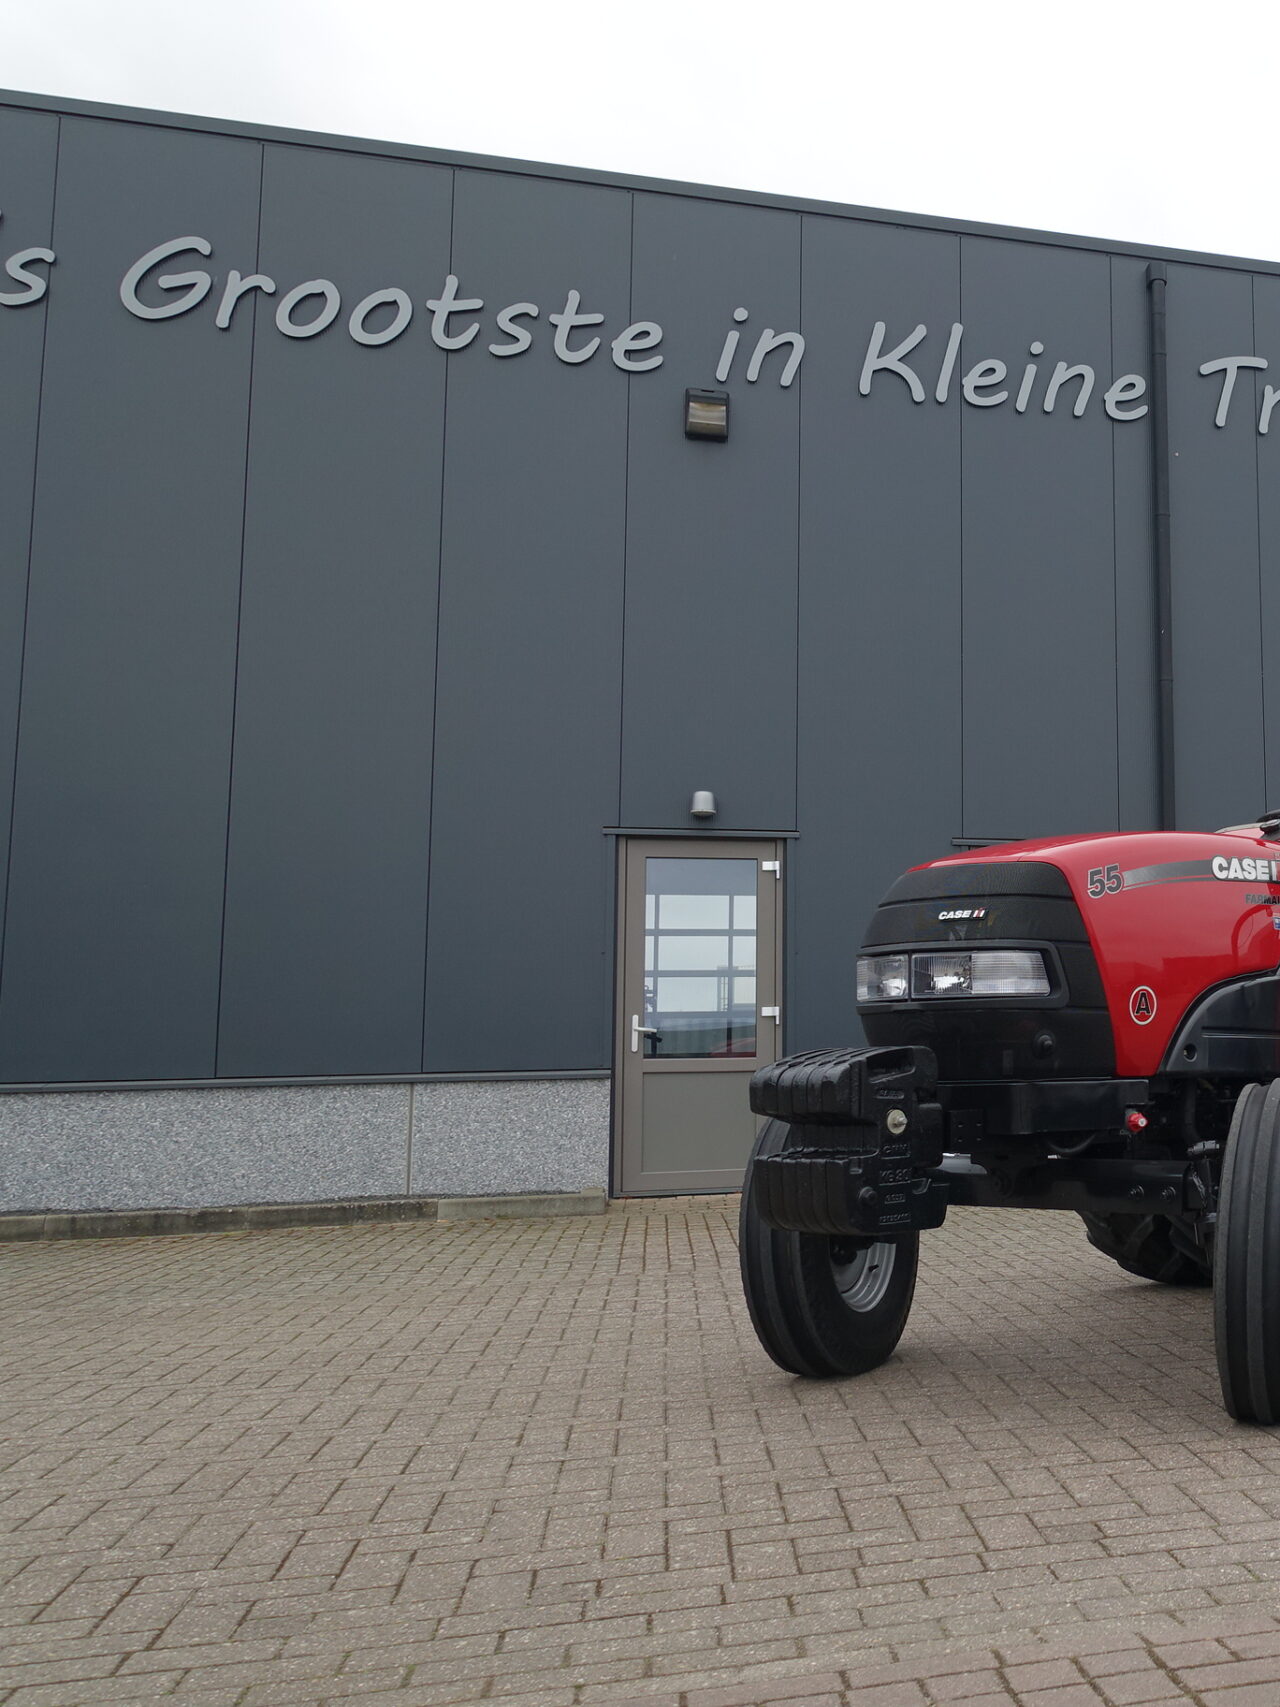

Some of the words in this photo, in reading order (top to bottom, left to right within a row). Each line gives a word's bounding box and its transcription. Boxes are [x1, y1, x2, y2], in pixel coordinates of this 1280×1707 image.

[119, 235, 665, 372] Grootste
[715, 307, 806, 387] in
[858, 321, 1150, 421] Kleine
[1212, 856, 1270, 880] CASE
[1087, 863, 1123, 899] 55
[938, 910, 972, 920] CASE
[1134, 991, 1152, 1016] A
